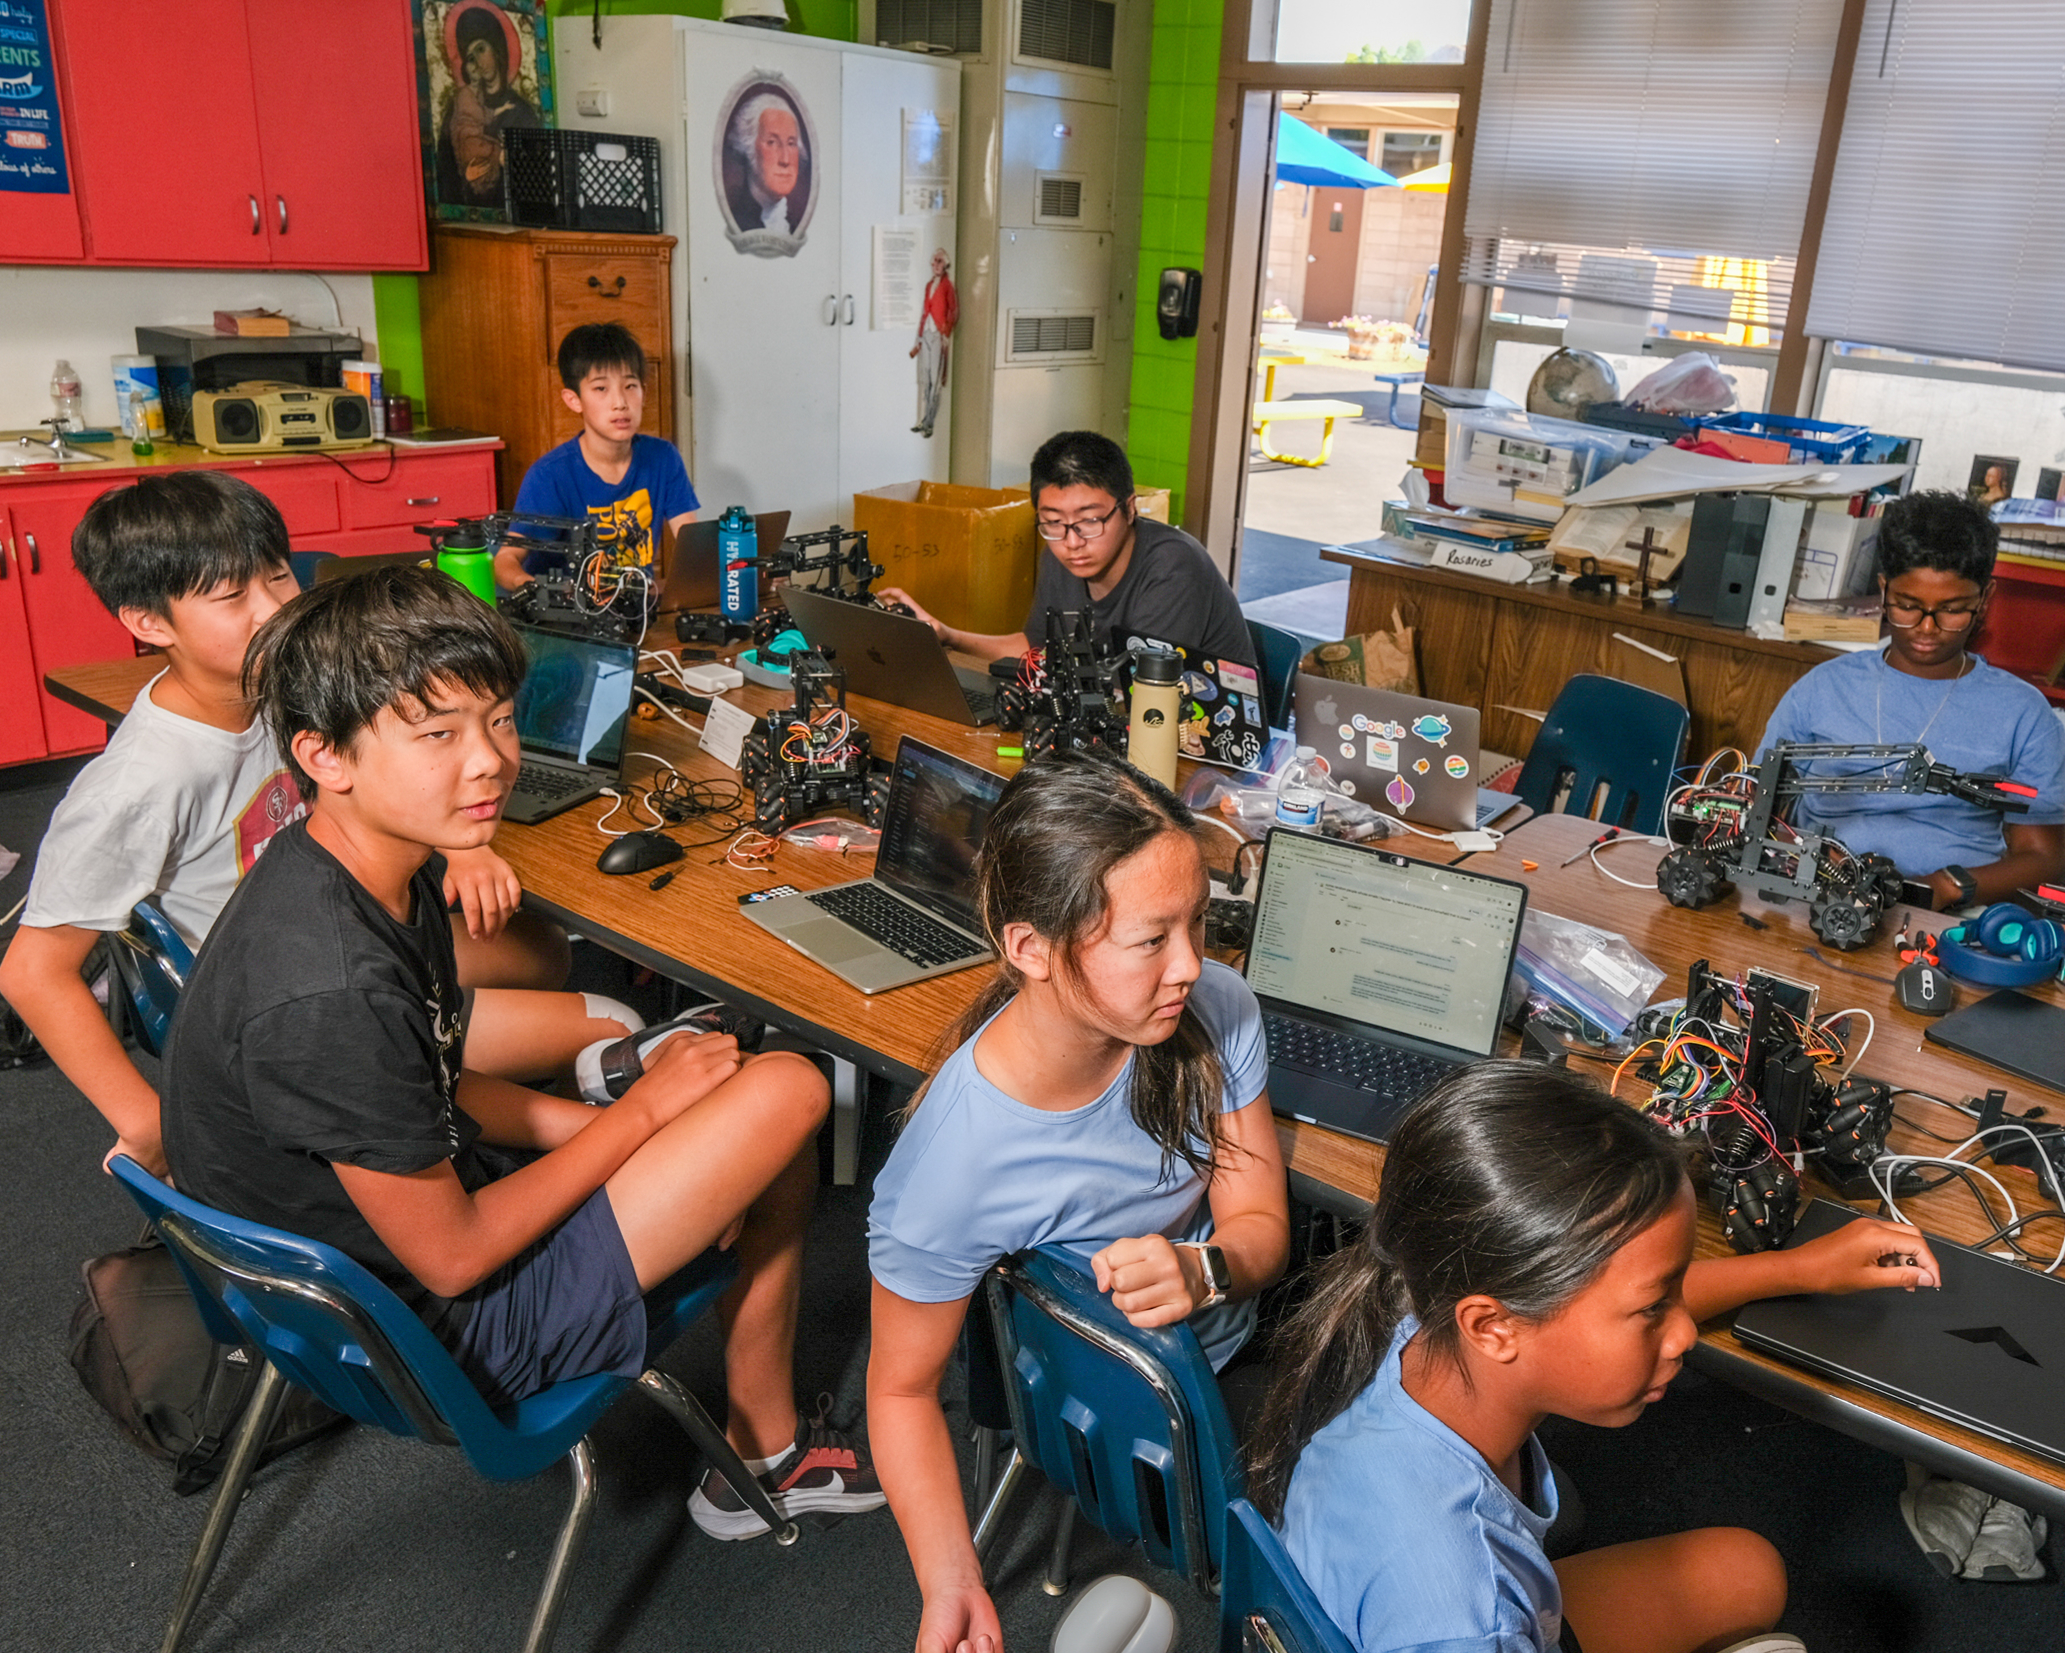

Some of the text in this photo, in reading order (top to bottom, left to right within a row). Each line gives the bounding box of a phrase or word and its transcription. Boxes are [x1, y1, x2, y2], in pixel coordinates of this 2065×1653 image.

[0, 46, 42, 68] ENTS
[1446, 549, 1494, 567] Rosaries
[726, 541, 740, 611] HYRATED
[1354, 715, 1405, 739] Google
